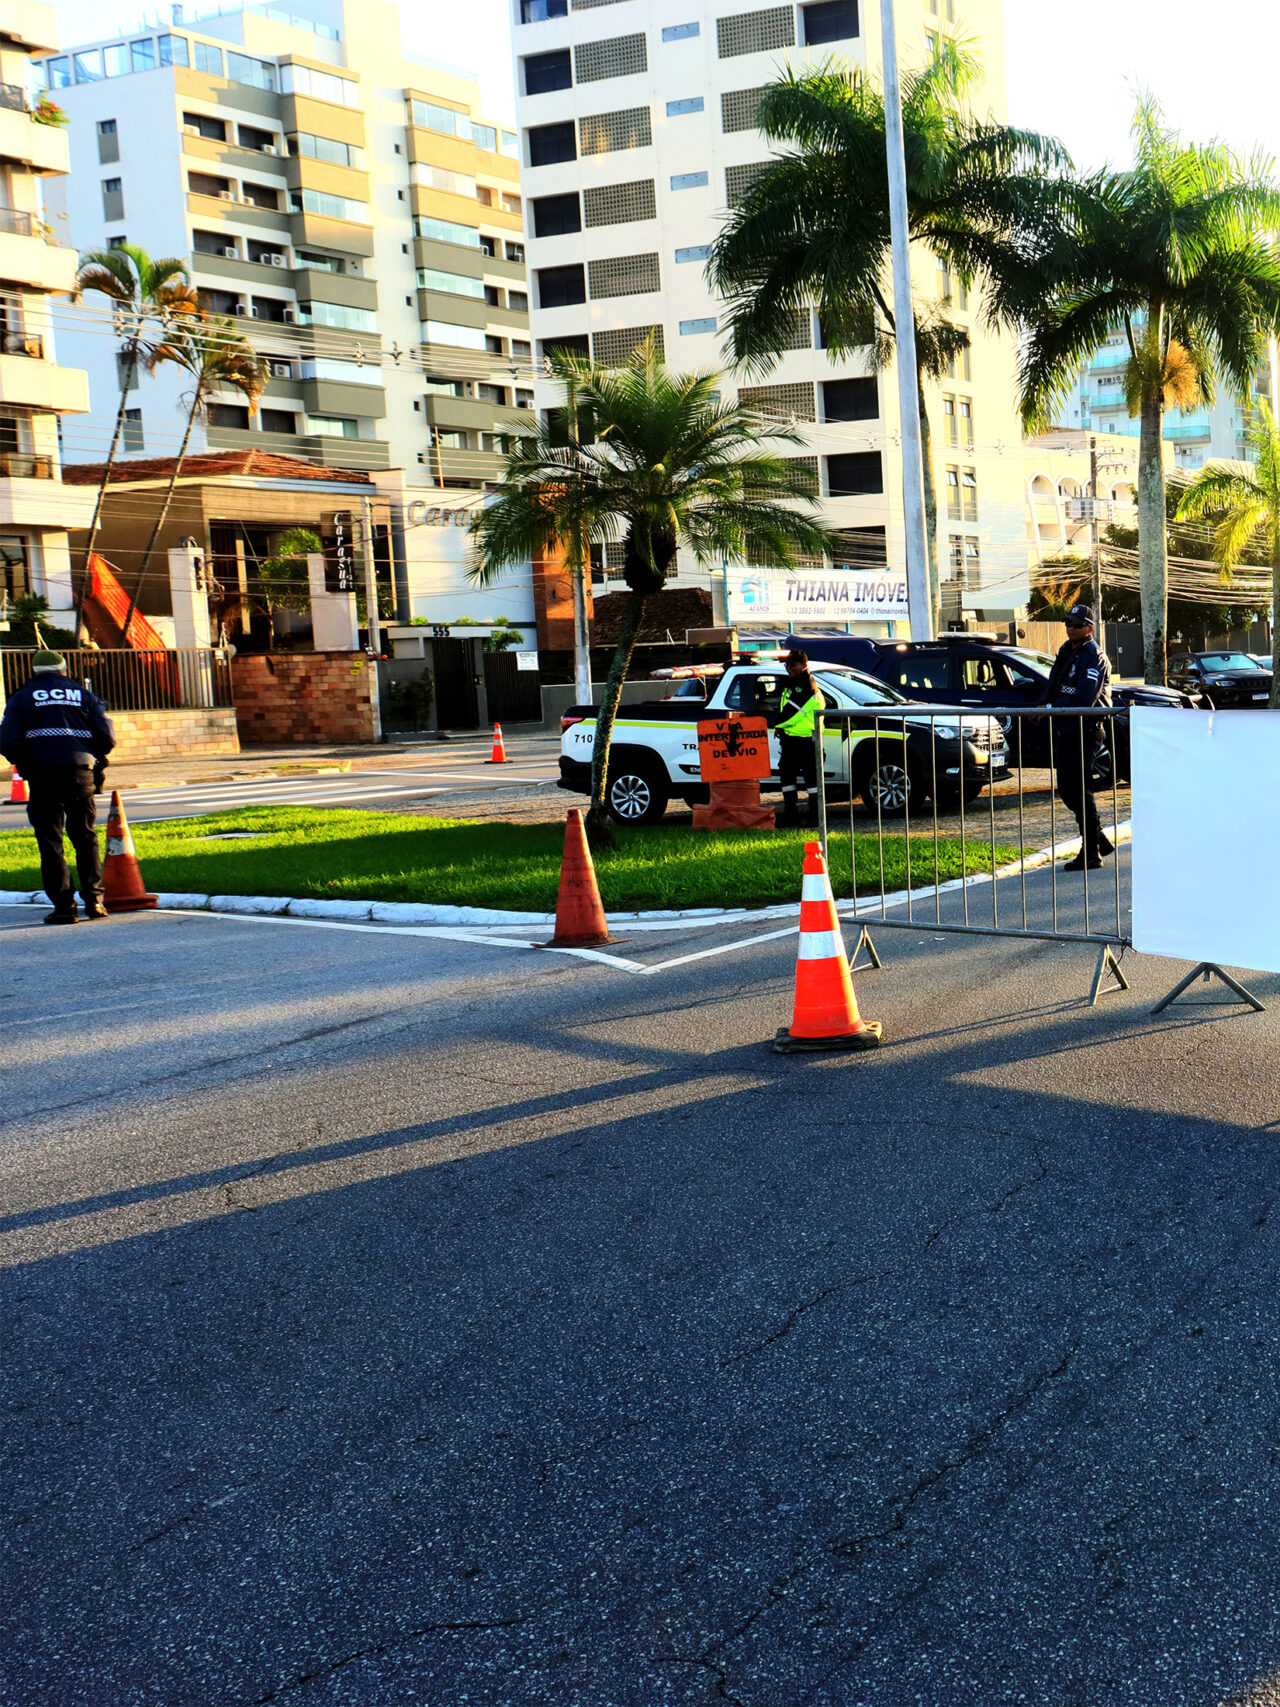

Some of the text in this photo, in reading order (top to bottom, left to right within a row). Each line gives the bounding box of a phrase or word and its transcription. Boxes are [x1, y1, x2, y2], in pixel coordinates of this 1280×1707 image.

[786, 576, 909, 603] THIANA IMÓVE
[432, 626, 451, 637] 555
[32, 689, 82, 701] GCM
[574, 733, 593, 744] 710
[698, 730, 767, 743] INTERITADA
[713, 747, 757, 759] DEVIO
